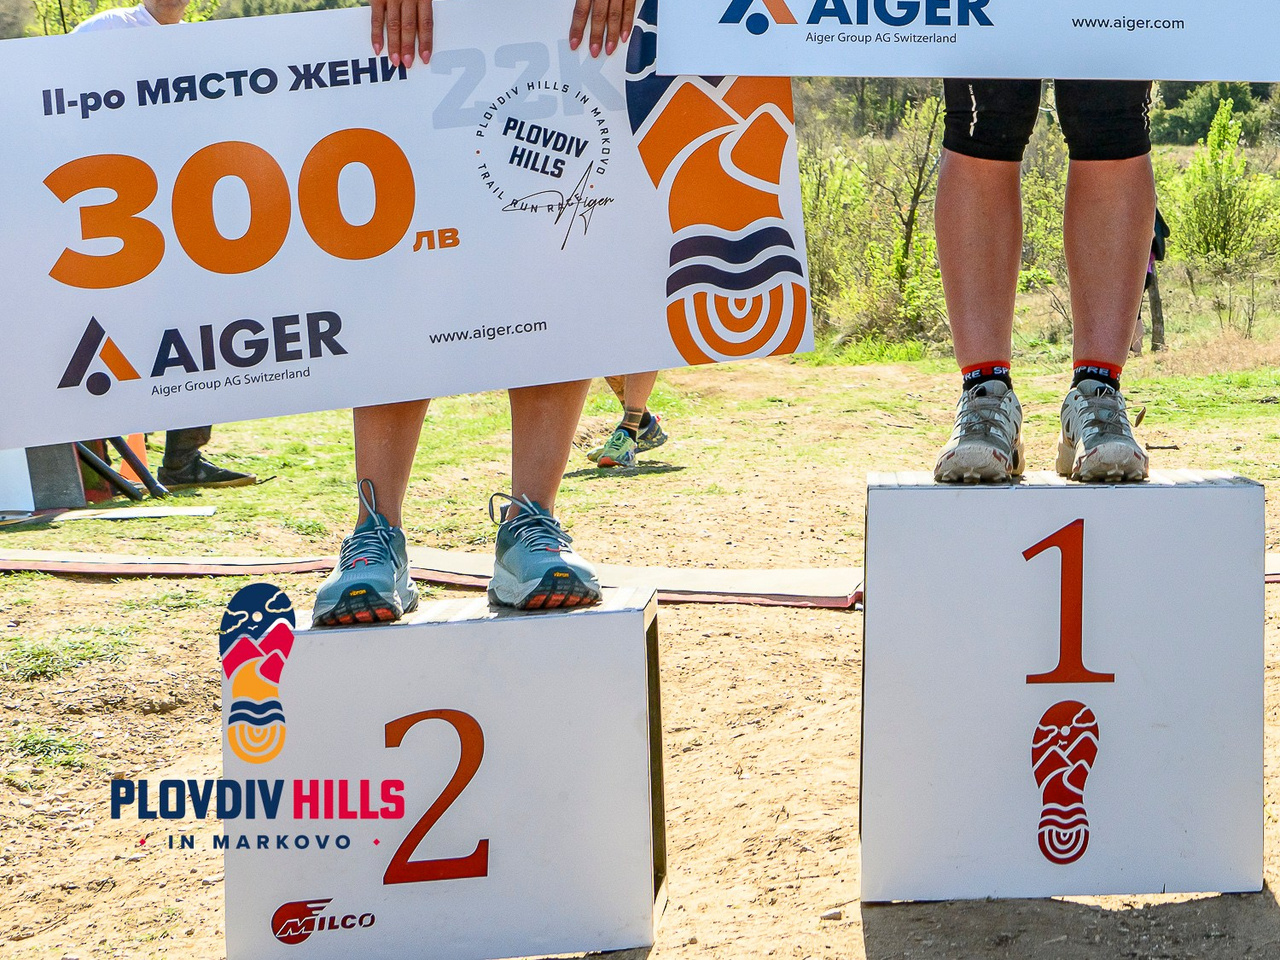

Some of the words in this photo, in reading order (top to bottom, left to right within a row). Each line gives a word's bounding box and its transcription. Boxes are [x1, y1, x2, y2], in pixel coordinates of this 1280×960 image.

[806, 32, 835, 44] Aiger
[838, 33, 872, 44] Group
[875, 33, 890, 43] AG
[894, 33, 957, 43] Switzerland
[1072, 16, 1184, 31] www.aiger.com
[136, 68, 279, 106] МЯСТО
[287, 56, 408, 92] ЖЕНИ
[476, 87, 519, 137] PLOVDIV
[527, 81, 570, 93] HILLS
[575, 91, 590, 105] IN
[591, 107, 611, 175] MARKOVO
[502, 117, 589, 158] PLOVDIV
[509, 146, 566, 179] HILLS
[42, 127, 416, 289] 300
[412, 227, 461, 253] лв
[478, 163, 504, 200] TRAIL
[510, 199, 538, 213] RUN
[150, 310, 348, 378] AIGER
[429, 321, 547, 344] www.aiger.com
[151, 384, 182, 397] Aiger
[185, 378, 221, 391] Group
[224, 375, 241, 387] AG
[244, 367, 311, 385] Switzerland
[1021, 518, 1115, 684] 1
[383, 708, 489, 885] 2
[276, 913, 375, 938] MILCO
